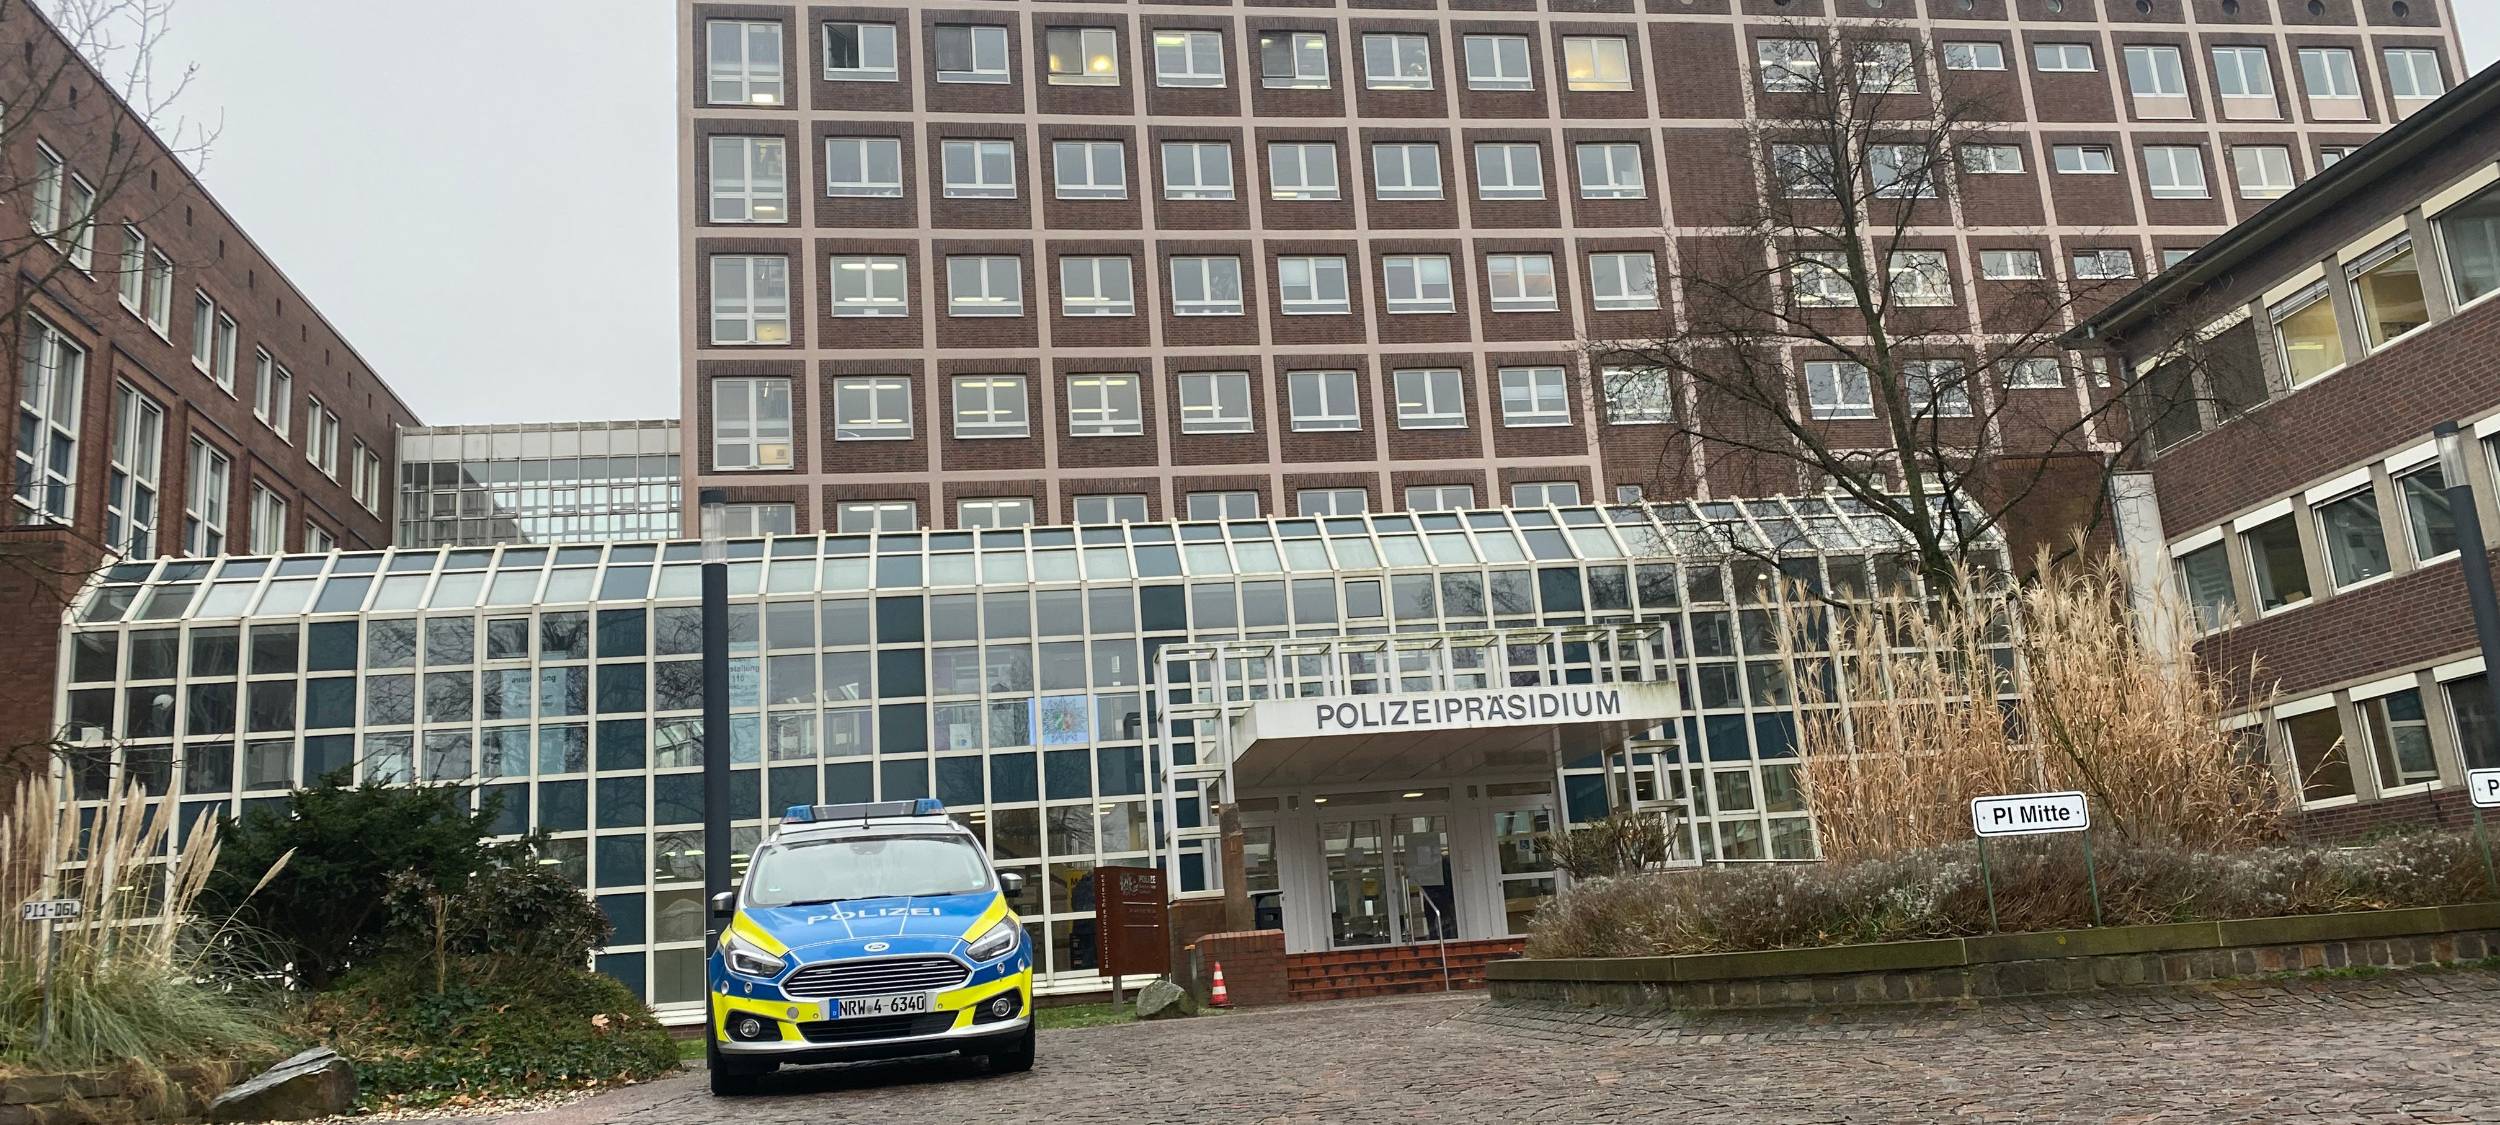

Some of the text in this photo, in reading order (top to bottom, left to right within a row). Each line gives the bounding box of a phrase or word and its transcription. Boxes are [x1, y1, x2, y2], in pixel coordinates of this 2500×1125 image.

[1316, 690, 1621, 729] POLIZEIPRÄSIDIUM
[1993, 805, 2070, 825] PI Mitte
[807, 907, 941, 925] POLIZEI
[839, 1000, 866, 1016] NRW
